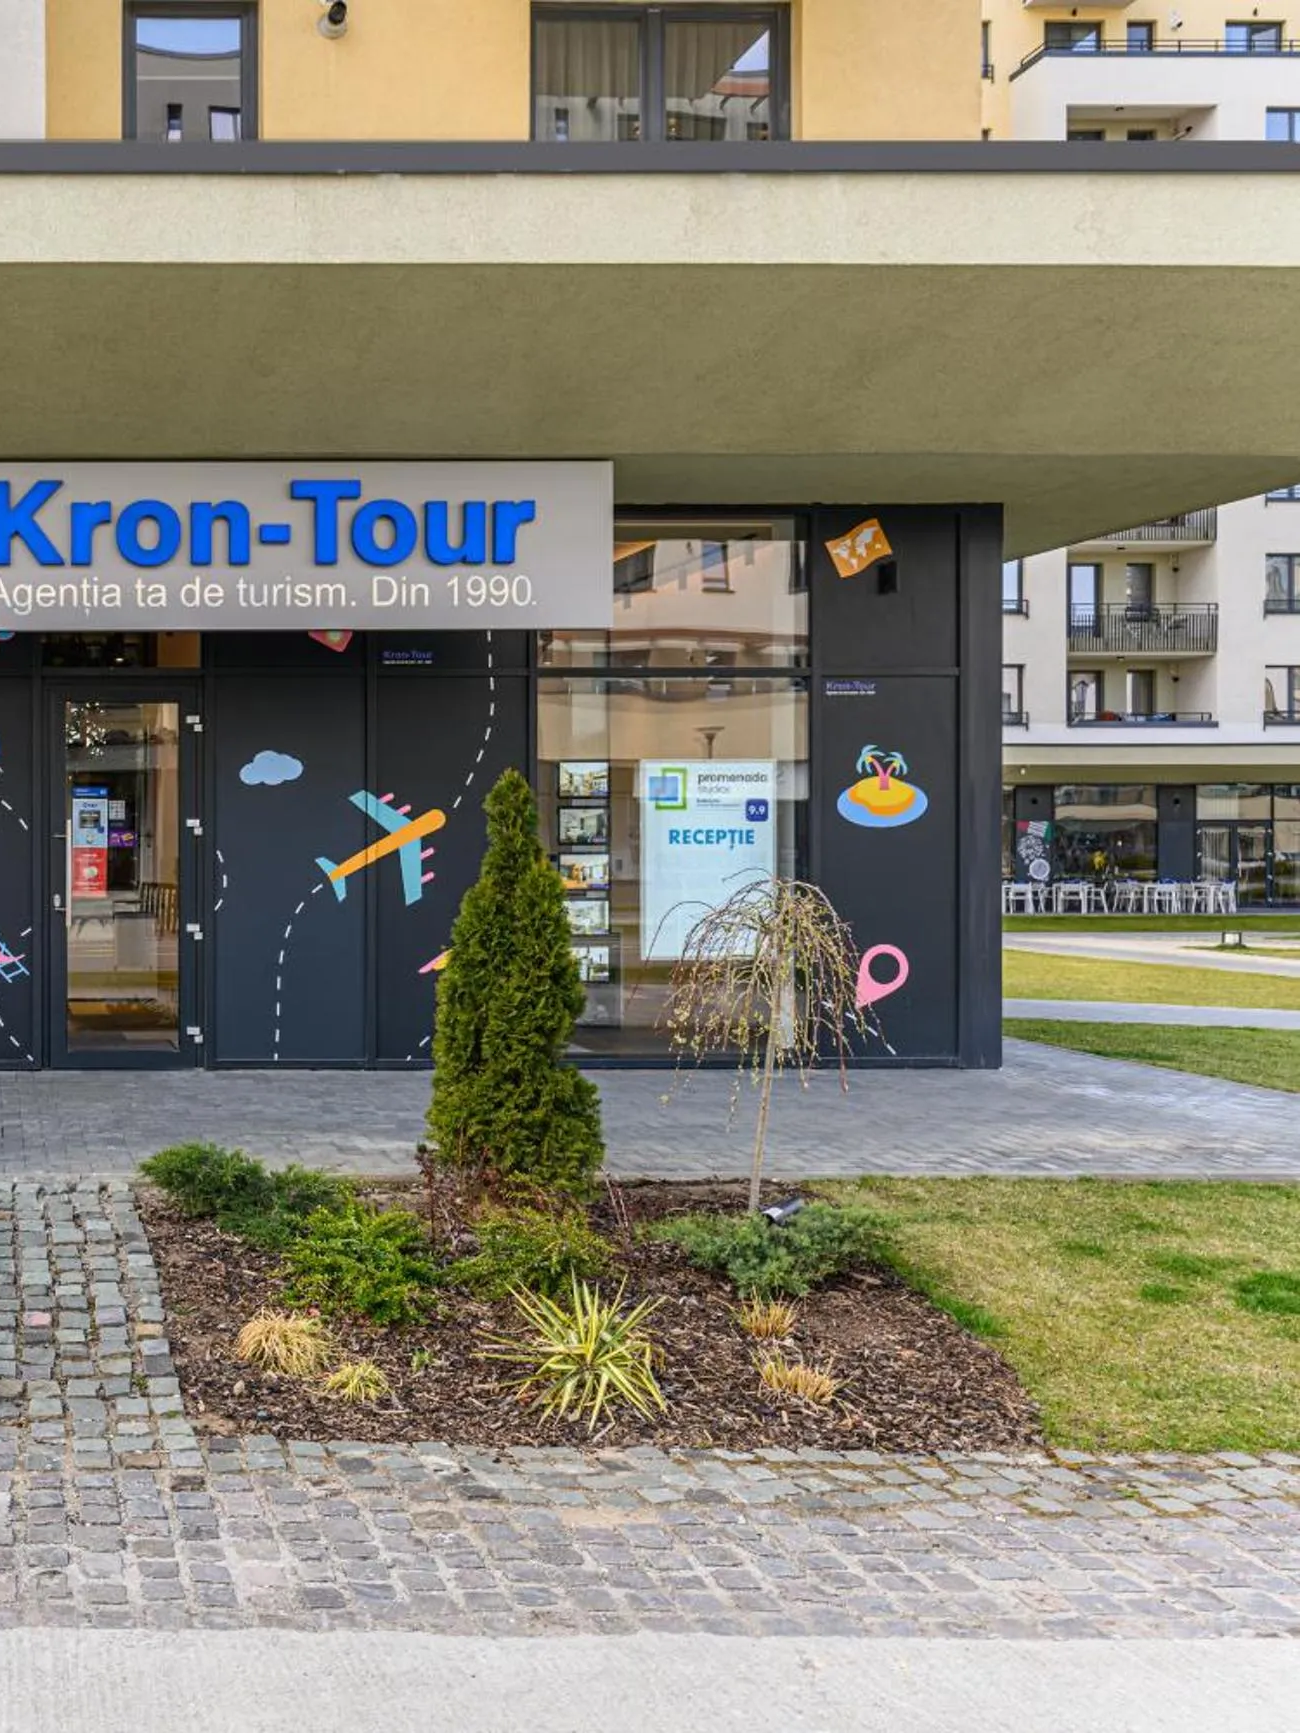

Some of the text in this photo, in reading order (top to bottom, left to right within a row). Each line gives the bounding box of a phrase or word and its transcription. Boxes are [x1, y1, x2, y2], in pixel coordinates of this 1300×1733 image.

[135, 577, 167, 607] ta
[180, 575, 225, 607] de
[236, 575, 356, 607] turism.
[372, 575, 429, 607] Din
[446, 575, 537, 607] 1990.
[697, 772, 768, 784] promenada
[748, 805, 766, 816] 9.9
[668, 829, 756, 850] RECEPȚIE
